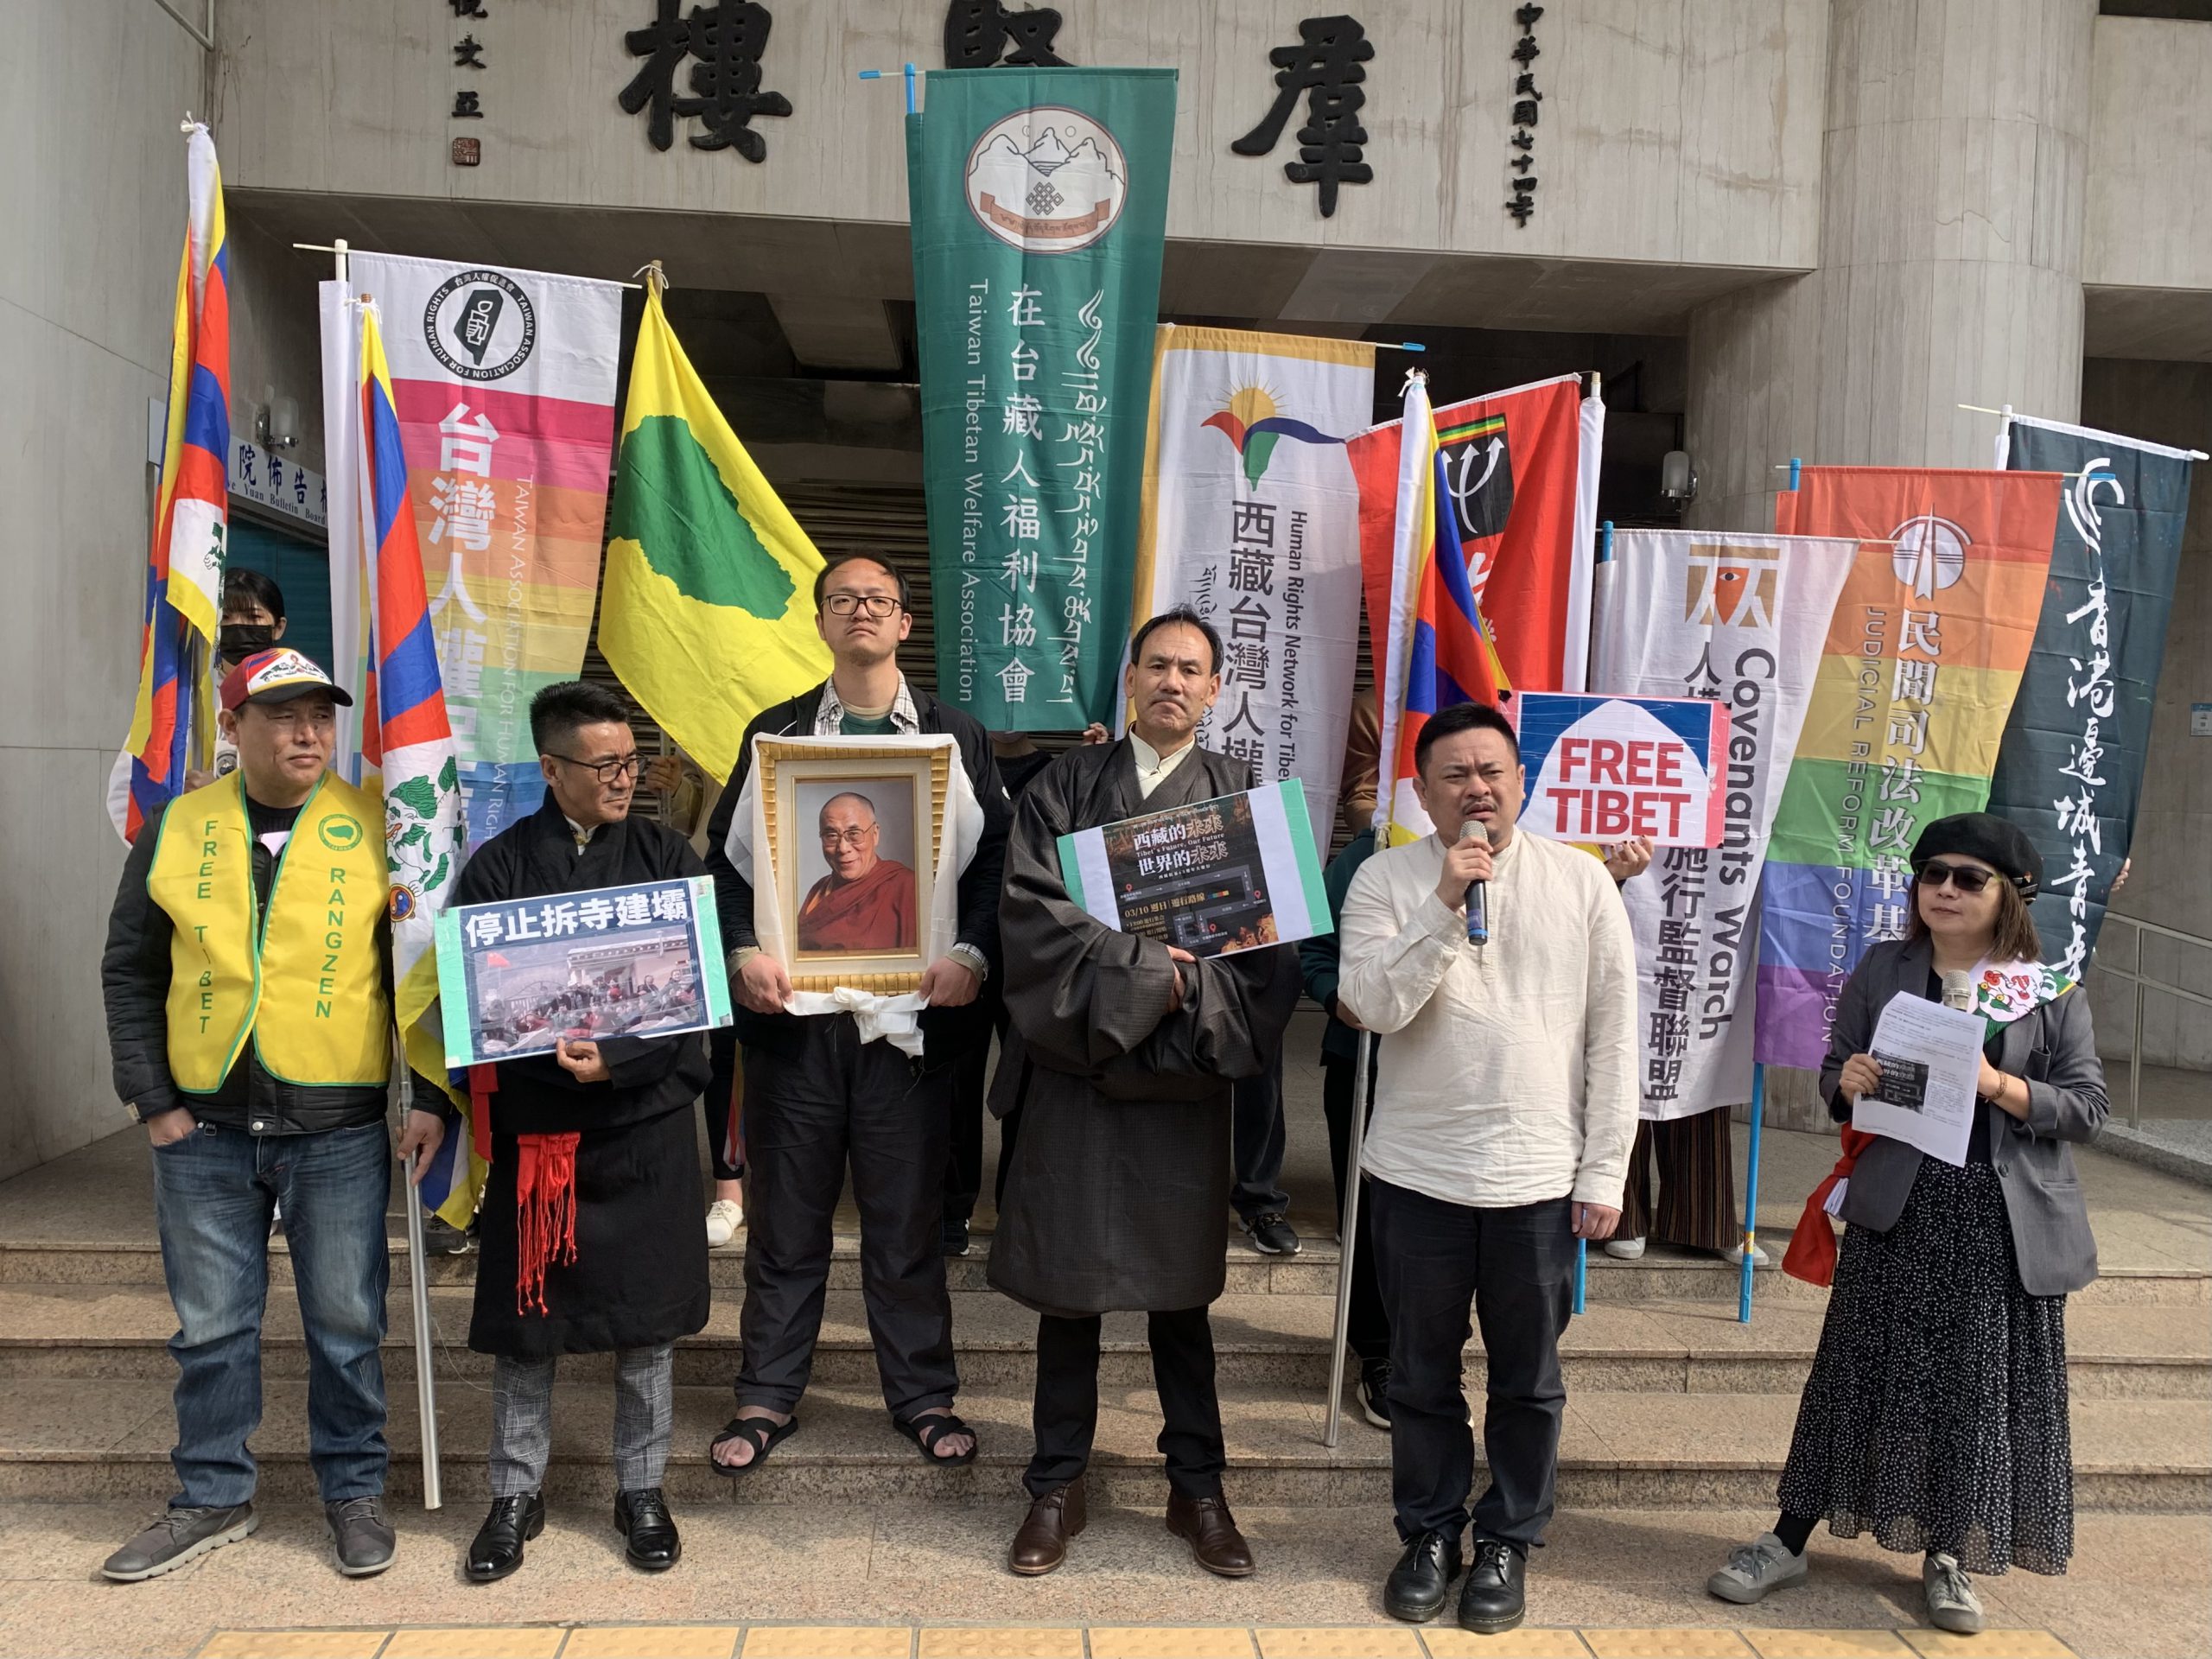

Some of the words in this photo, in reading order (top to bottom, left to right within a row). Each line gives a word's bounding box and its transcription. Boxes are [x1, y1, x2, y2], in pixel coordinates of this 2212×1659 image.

[1506, 3, 1542, 227] 中華民國七十四年
[427, 287, 449, 322] RIGHTS
[518, 295, 533, 336] TAIWAN
[968, 278, 988, 365] Taiwan
[427, 325, 448, 362] HUMAN
[449, 362, 469, 375] FOR
[473, 338, 531, 378] ASSOCIATION
[964, 374, 986, 463] Tibetan
[245, 483, 264, 501] Yuan
[270, 493, 298, 514] Bulletin
[305, 508, 326, 525] Board
[512, 474, 533, 551] TAIWAN
[963, 472, 983, 563] Welfare
[995, 283, 1046, 704] 在台藏人福利協會
[1288, 511, 1307, 571] Human
[428, 402, 499, 840] 台灣人權
[500, 555, 526, 675] ASSOCIATION
[958, 571, 981, 702] Association
[1282, 576, 1304, 630] Rights
[499, 677, 516, 715] FOR
[1281, 635, 1302, 709] Network
[1853, 607, 1885, 729] JUDICIAL
[491, 720, 513, 792] HUMAN
[1278, 743, 1295, 782] Tibe
[1280, 714, 1298, 739] for
[1559, 737, 1684, 787] FREE
[1719, 648, 1776, 885] Covenants
[1837, 741, 1870, 853] REFORM
[485, 797, 504, 840] RIGH
[1133, 814, 1224, 851] 西藏的未來
[1546, 788, 1691, 837] TIBET
[197, 820, 219, 899] FREE
[1137, 840, 1229, 877] 世界的未來
[315, 868, 346, 1019] RANGZEN
[465, 887, 689, 948] 停止拆寺建壩
[1124, 906, 1149, 918] 03/10
[194, 925, 214, 1034] TIBET
[1699, 905, 1745, 1039] Watch
[1821, 866, 1853, 1042] FOUNDATION
